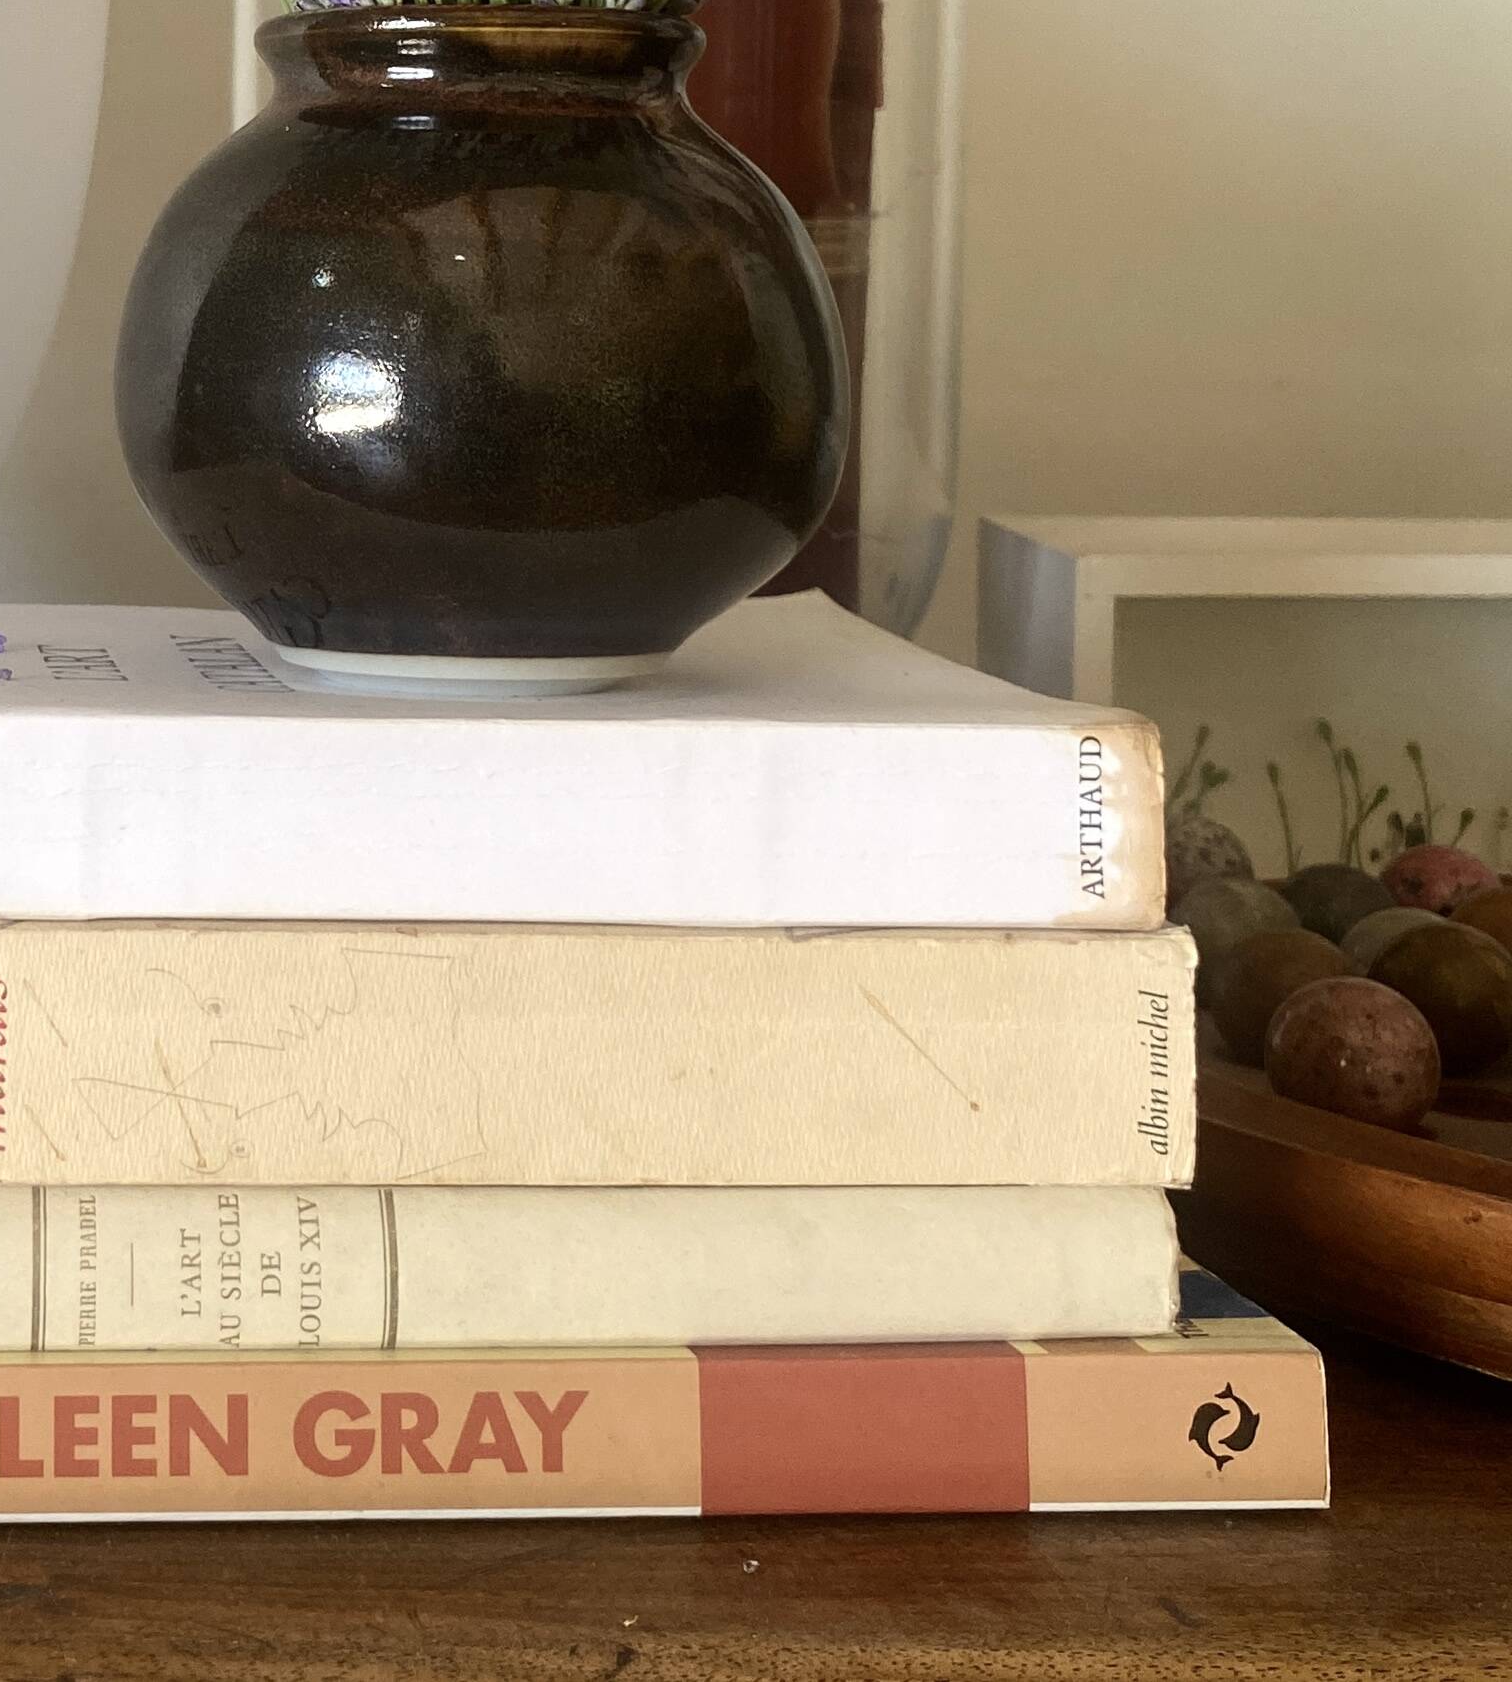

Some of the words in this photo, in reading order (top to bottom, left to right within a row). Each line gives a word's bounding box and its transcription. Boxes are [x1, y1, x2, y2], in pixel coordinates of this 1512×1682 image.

[1078, 734, 1105, 900] ARTHAUD
[1137, 989, 1169, 1079] michel
[1137, 1088, 1169, 1156] albin
[79, 1194, 98, 1272] PRADEL
[217, 1192, 243, 1301] SIÈCLE
[296, 1195, 321, 1252] XIV
[78, 1280, 97, 1347] PIERRE
[179, 1227, 202, 1319] L'ART
[260, 1250, 282, 1298] DE
[297, 1260, 323, 1348] LOUIS
[219, 1313, 243, 1349] AU
[292, 1388, 590, 1479] GRAY
